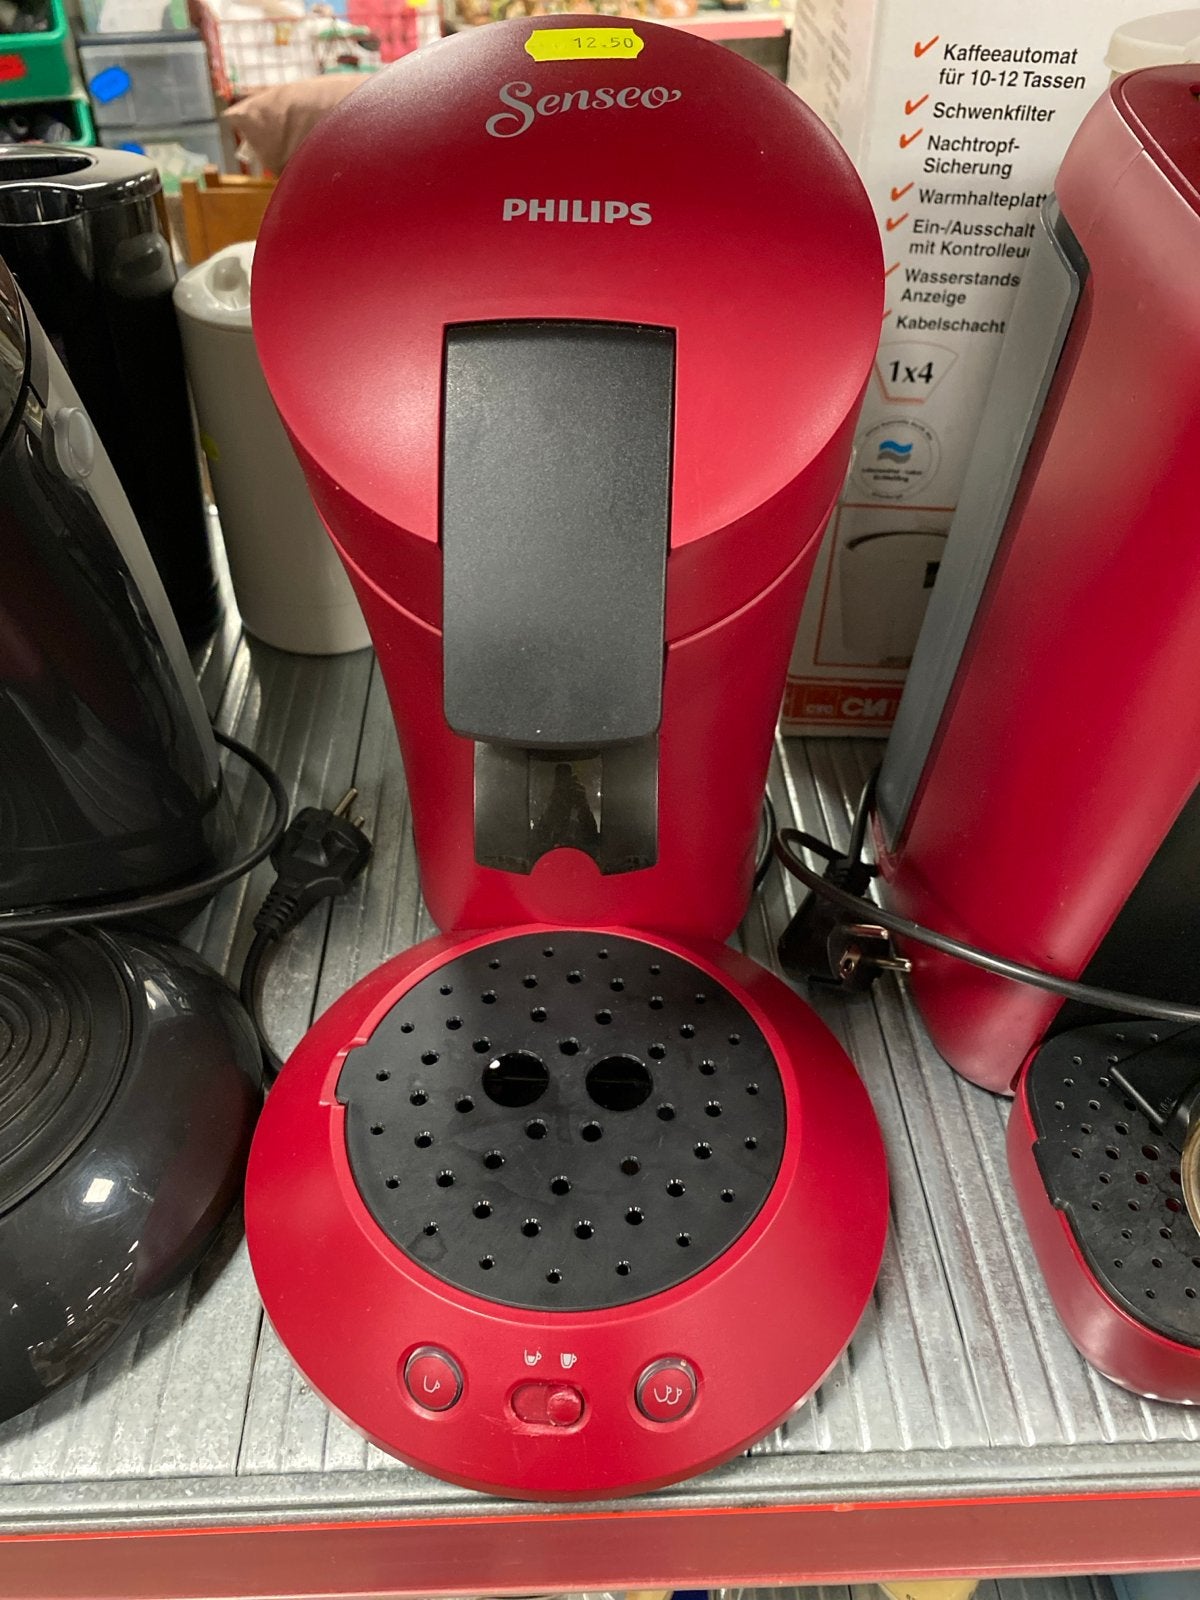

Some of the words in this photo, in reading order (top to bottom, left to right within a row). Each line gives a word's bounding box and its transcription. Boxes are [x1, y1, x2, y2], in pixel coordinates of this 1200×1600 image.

[574, 37, 634, 49] 12.50
[943, 43, 1078, 65] Kaffeeautomat
[939, 68, 965, 86] für
[971, 70, 1018, 87] 10-12
[1023, 71, 1086, 89] Tassen
[485, 81, 682, 138] Senseo
[933, 102, 1056, 122] Schwenkfilter
[927, 135, 1020, 156] Nachtropf-
[923, 158, 1013, 180] Sicherung
[502, 198, 653, 226] PHILIPS
[909, 241, 936, 256] mit
[940, 241, 1031, 258] Kontrolleu
[905, 268, 1021, 287] Wasserstands
[901, 288, 967, 307] Anzeige
[896, 316, 1006, 334] Kabelschacht
[889, 360, 934, 384] 1x4
